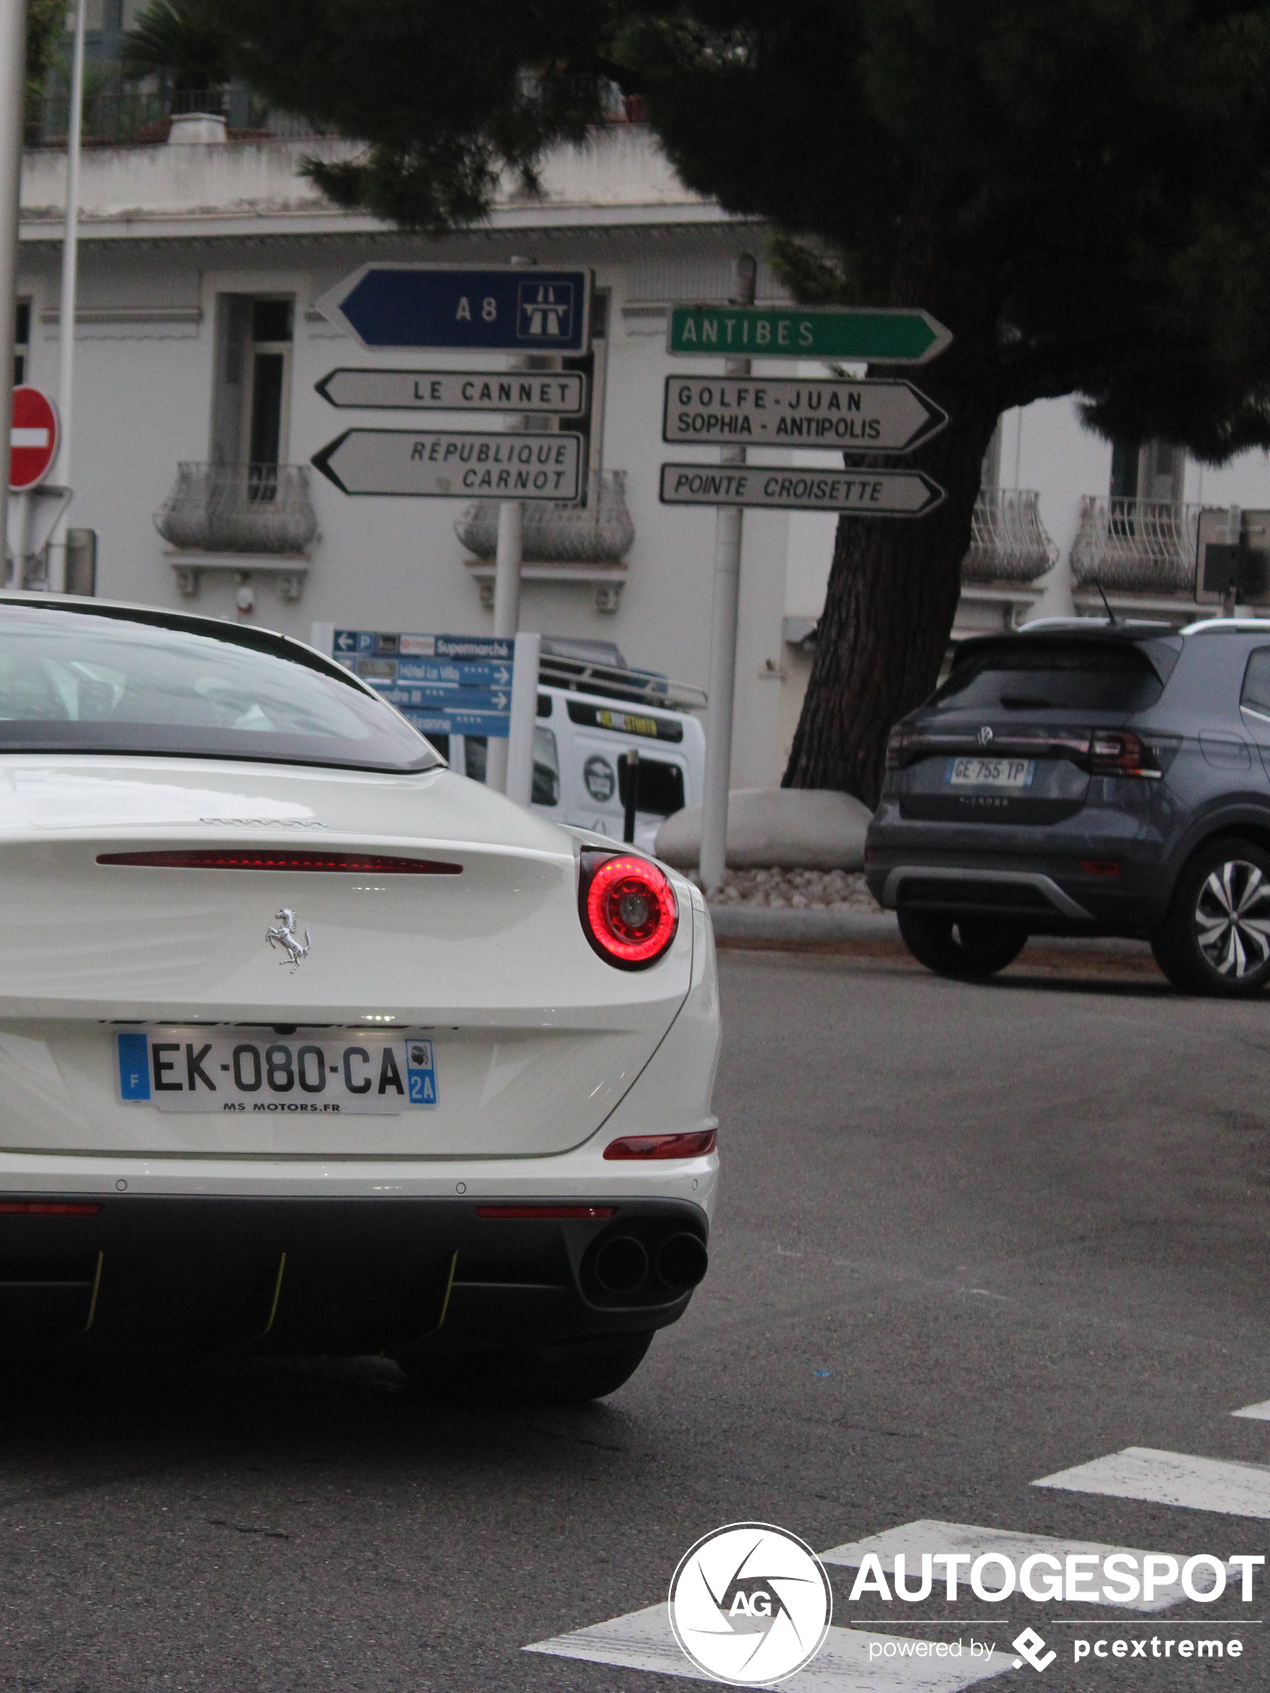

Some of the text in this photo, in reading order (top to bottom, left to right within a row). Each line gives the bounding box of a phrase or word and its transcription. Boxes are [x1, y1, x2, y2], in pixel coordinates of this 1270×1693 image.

[456, 296, 497, 321] A 8
[682, 318, 814, 346] ANTIBES
[414, 381, 570, 402] LE CANNET
[411, 437, 567, 464] RÉPUBLIQUE
[463, 470, 566, 490] CARNOT
[675, 474, 882, 501] POINTE CROISETTE
[130, 1074, 139, 1088] F
[152, 1043, 405, 1095] EK-080-CA
[411, 1076, 434, 1099] 2A
[223, 1103, 341, 1113] MS MOTORS.FR
